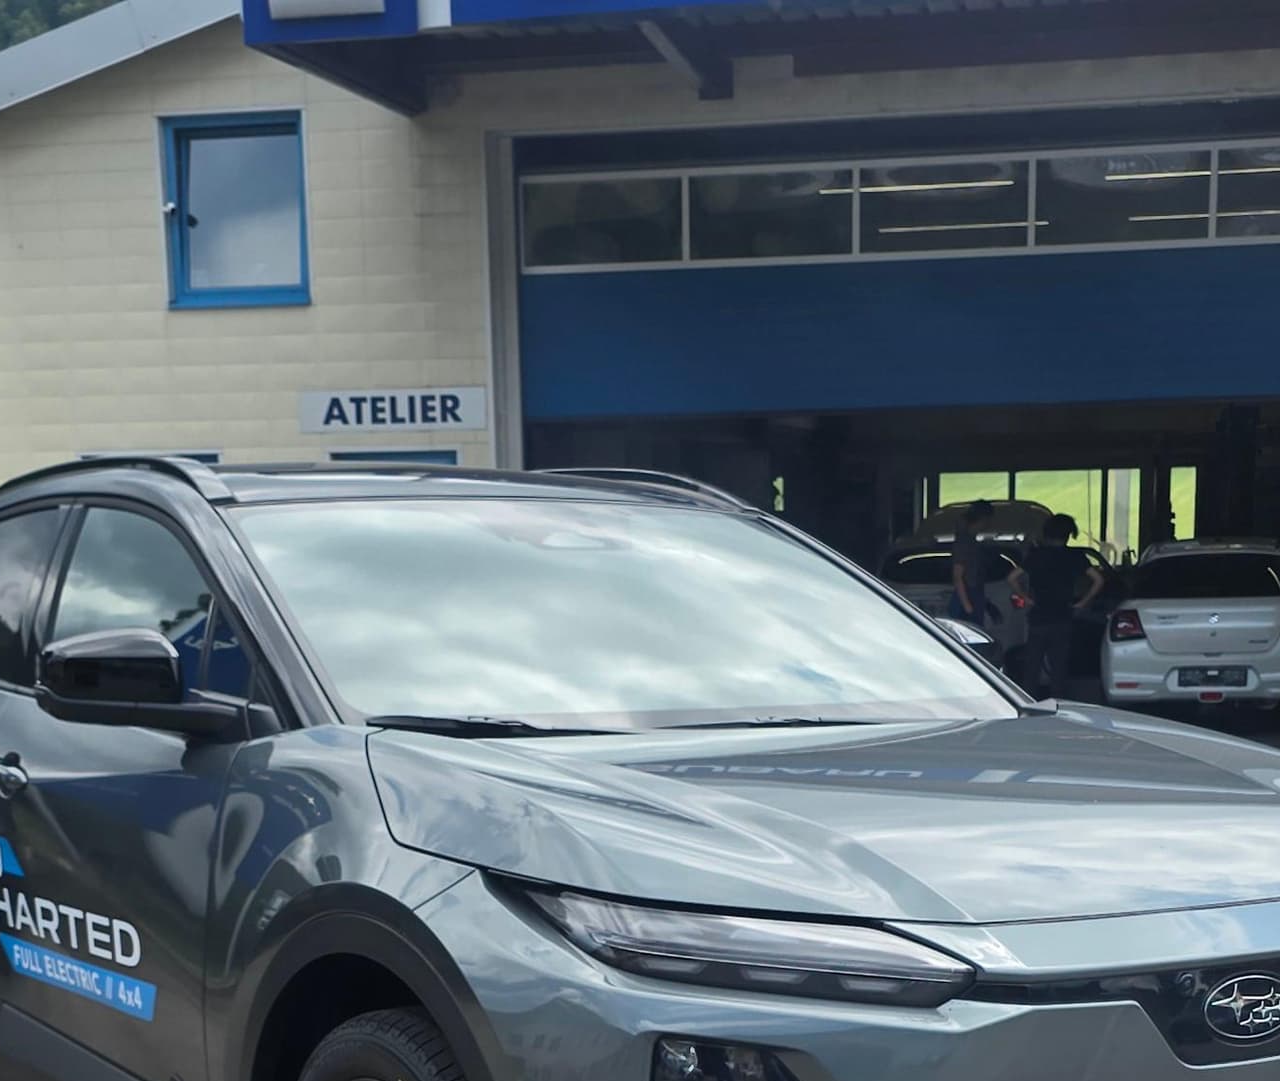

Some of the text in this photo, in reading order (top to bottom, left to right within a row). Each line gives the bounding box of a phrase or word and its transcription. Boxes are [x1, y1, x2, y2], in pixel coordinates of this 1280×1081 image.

[323, 394, 462, 425] ATELIER
[13, 944, 43, 974] FULL
[44, 955, 102, 995] ELECTRIC
[118, 980, 142, 1009] 4x4
